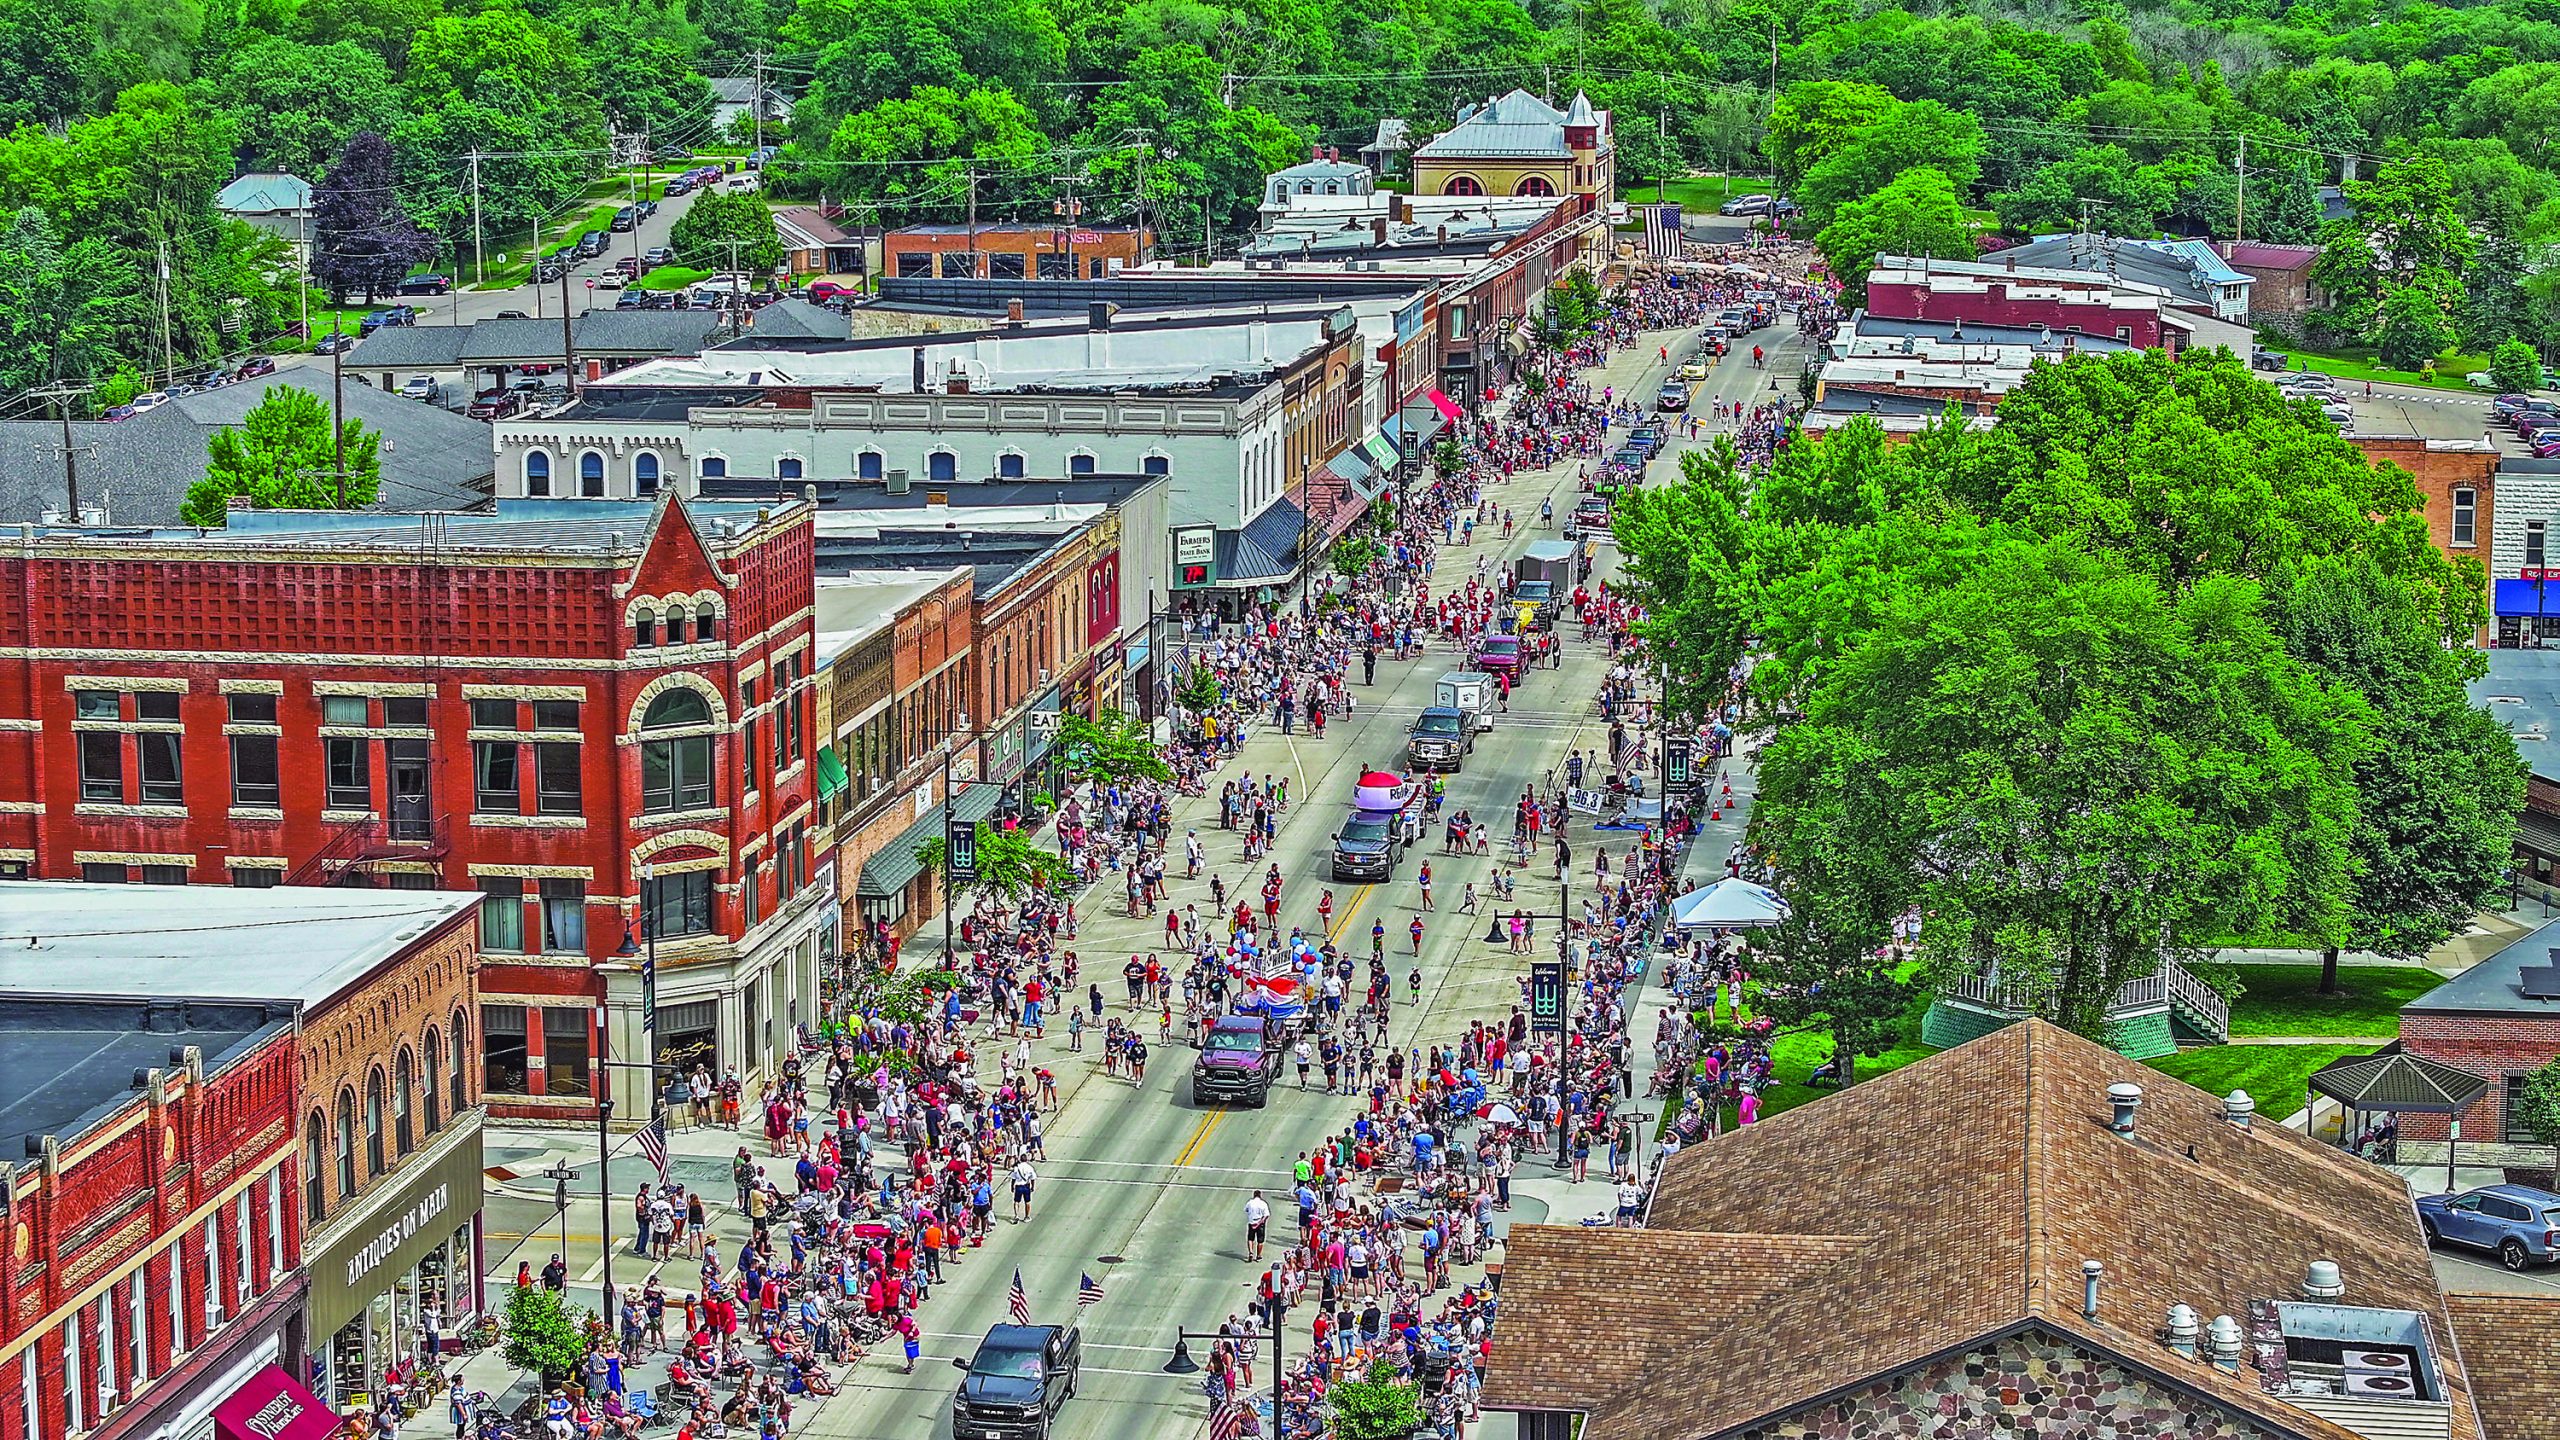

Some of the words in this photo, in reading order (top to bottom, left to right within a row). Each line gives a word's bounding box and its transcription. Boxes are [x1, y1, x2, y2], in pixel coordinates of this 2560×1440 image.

[1032, 714, 1060, 728] EAT
[1574, 789, 1599, 808] 96.3
[552, 1171, 570, 1179] UNION
[347, 1221, 400, 1288] ANTIQUES
[402, 1208, 417, 1240] ON
[419, 1182, 448, 1228] MAIN
[256, 1390, 293, 1425] SYNERGY
[267, 1403, 304, 1434] HomeCare
